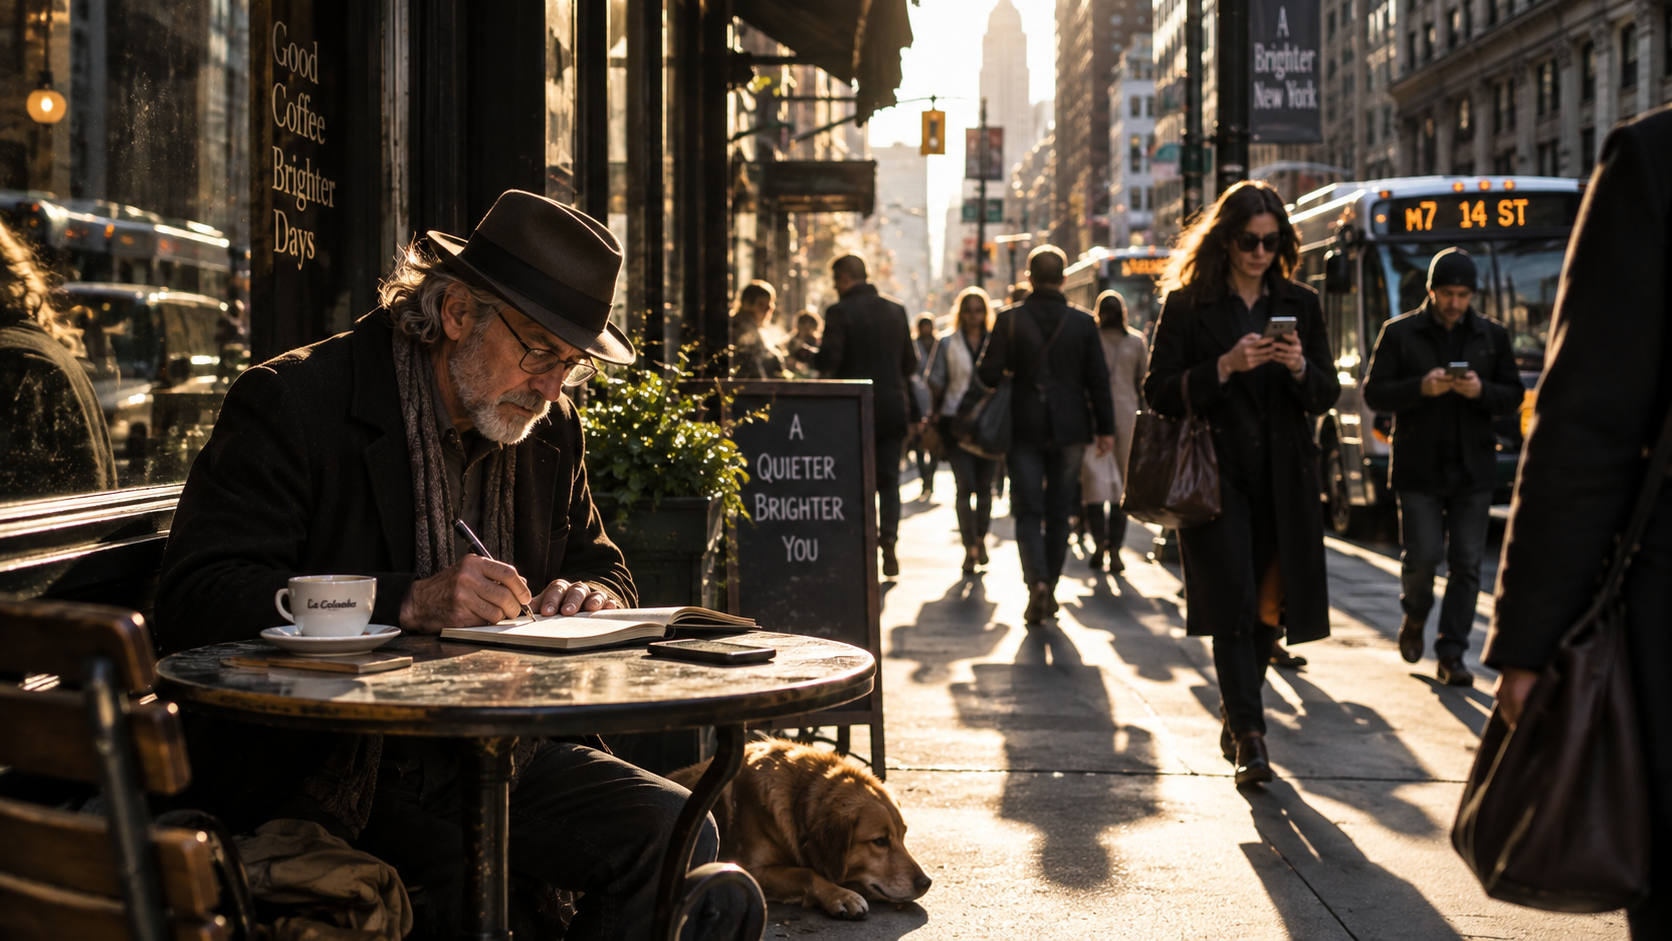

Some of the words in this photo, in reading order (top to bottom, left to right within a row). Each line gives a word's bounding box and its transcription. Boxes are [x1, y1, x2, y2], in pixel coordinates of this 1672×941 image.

[1276, 5, 1290, 38] A
[272, 21, 318, 84] Good
[1254, 42, 1316, 80] Brighter
[1253, 80, 1284, 109] New
[1285, 79, 1317, 109] York
[272, 82, 326, 145] Coffee
[272, 145, 336, 212] Brighter
[1405, 201, 1437, 231] M7
[1459, 200, 1487, 228] 14
[1498, 198, 1528, 226] ST
[273, 209, 315, 270] Days
[789, 413, 804, 440] A
[757, 453, 836, 483] QUIETER
[755, 493, 844, 521] BRIGHTER
[782, 535, 818, 562] YOU
